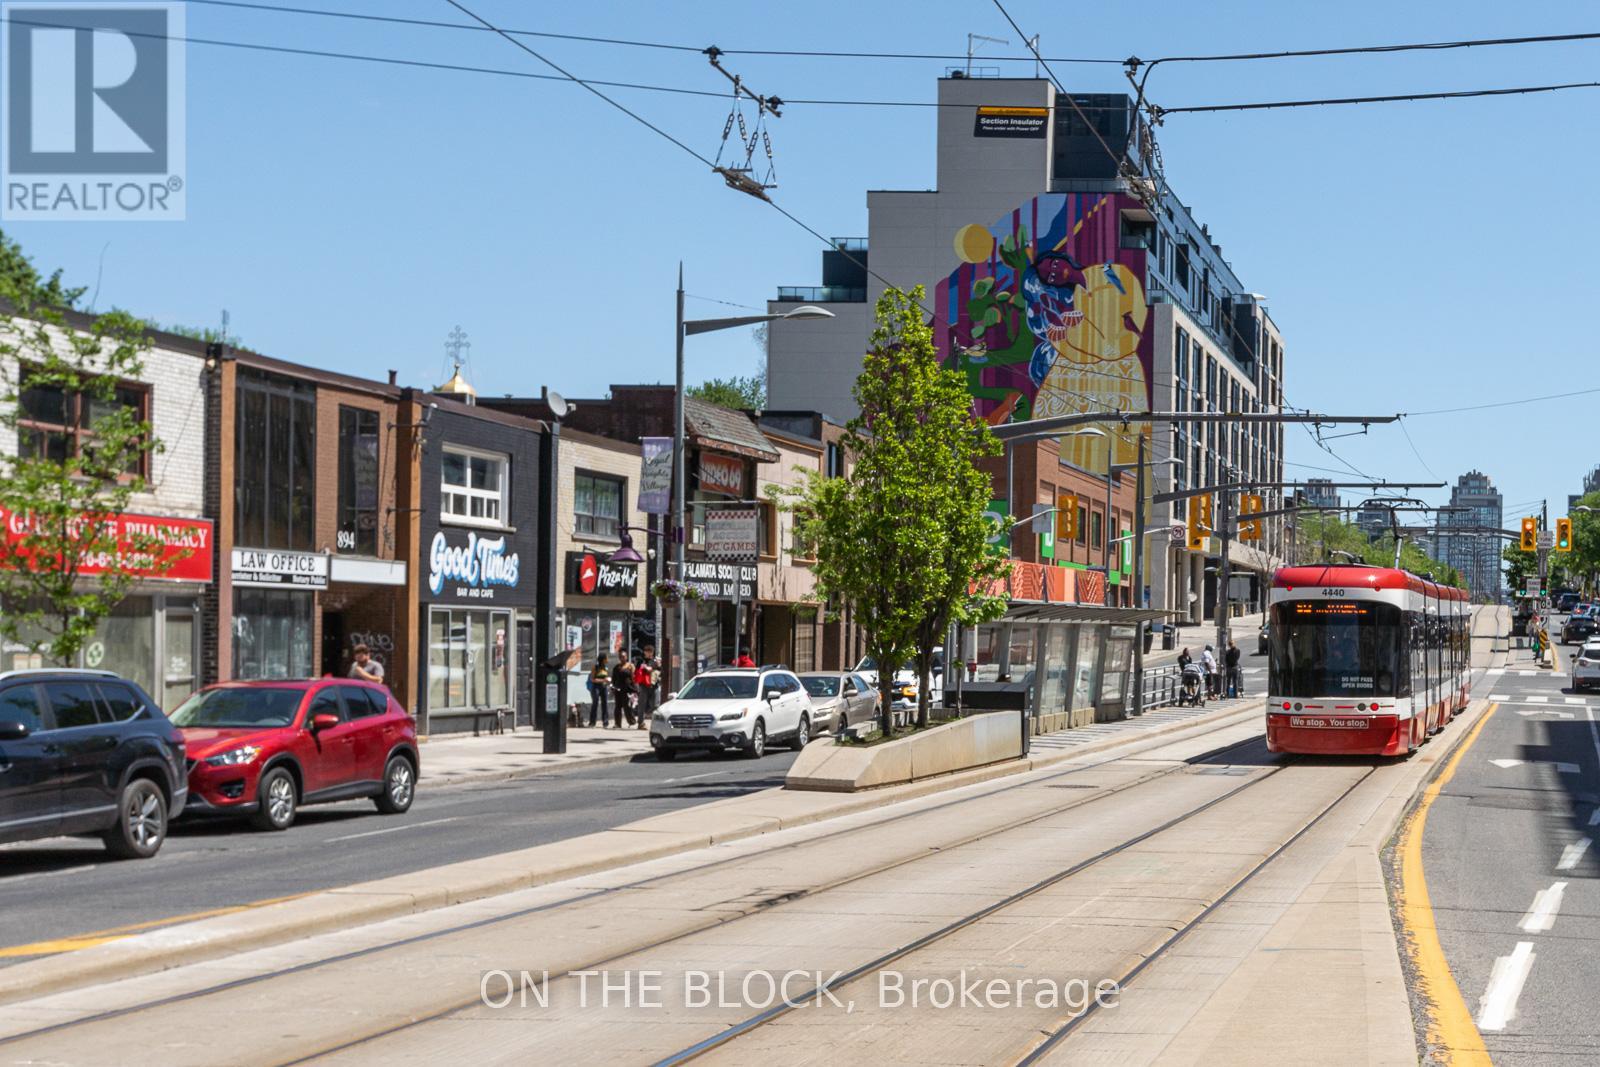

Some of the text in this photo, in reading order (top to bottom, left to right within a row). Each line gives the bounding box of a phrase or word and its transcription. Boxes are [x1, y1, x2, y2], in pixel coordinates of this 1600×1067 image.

[980, 117, 1044, 126] Section Insulator
[125, 522, 207, 548] PHARMACY
[337, 530, 355, 549] 894
[707, 542, 756, 551] PC GAMES
[241, 551, 316, 572] LAW OFFICE
[429, 531, 519, 595] Good Times
[597, 564, 638, 588] Pizza Hut
[718, 565, 738, 580] SOCI
[1322, 589, 1345, 597] 4440
[1292, 718, 1367, 728] We stop. You stop.
